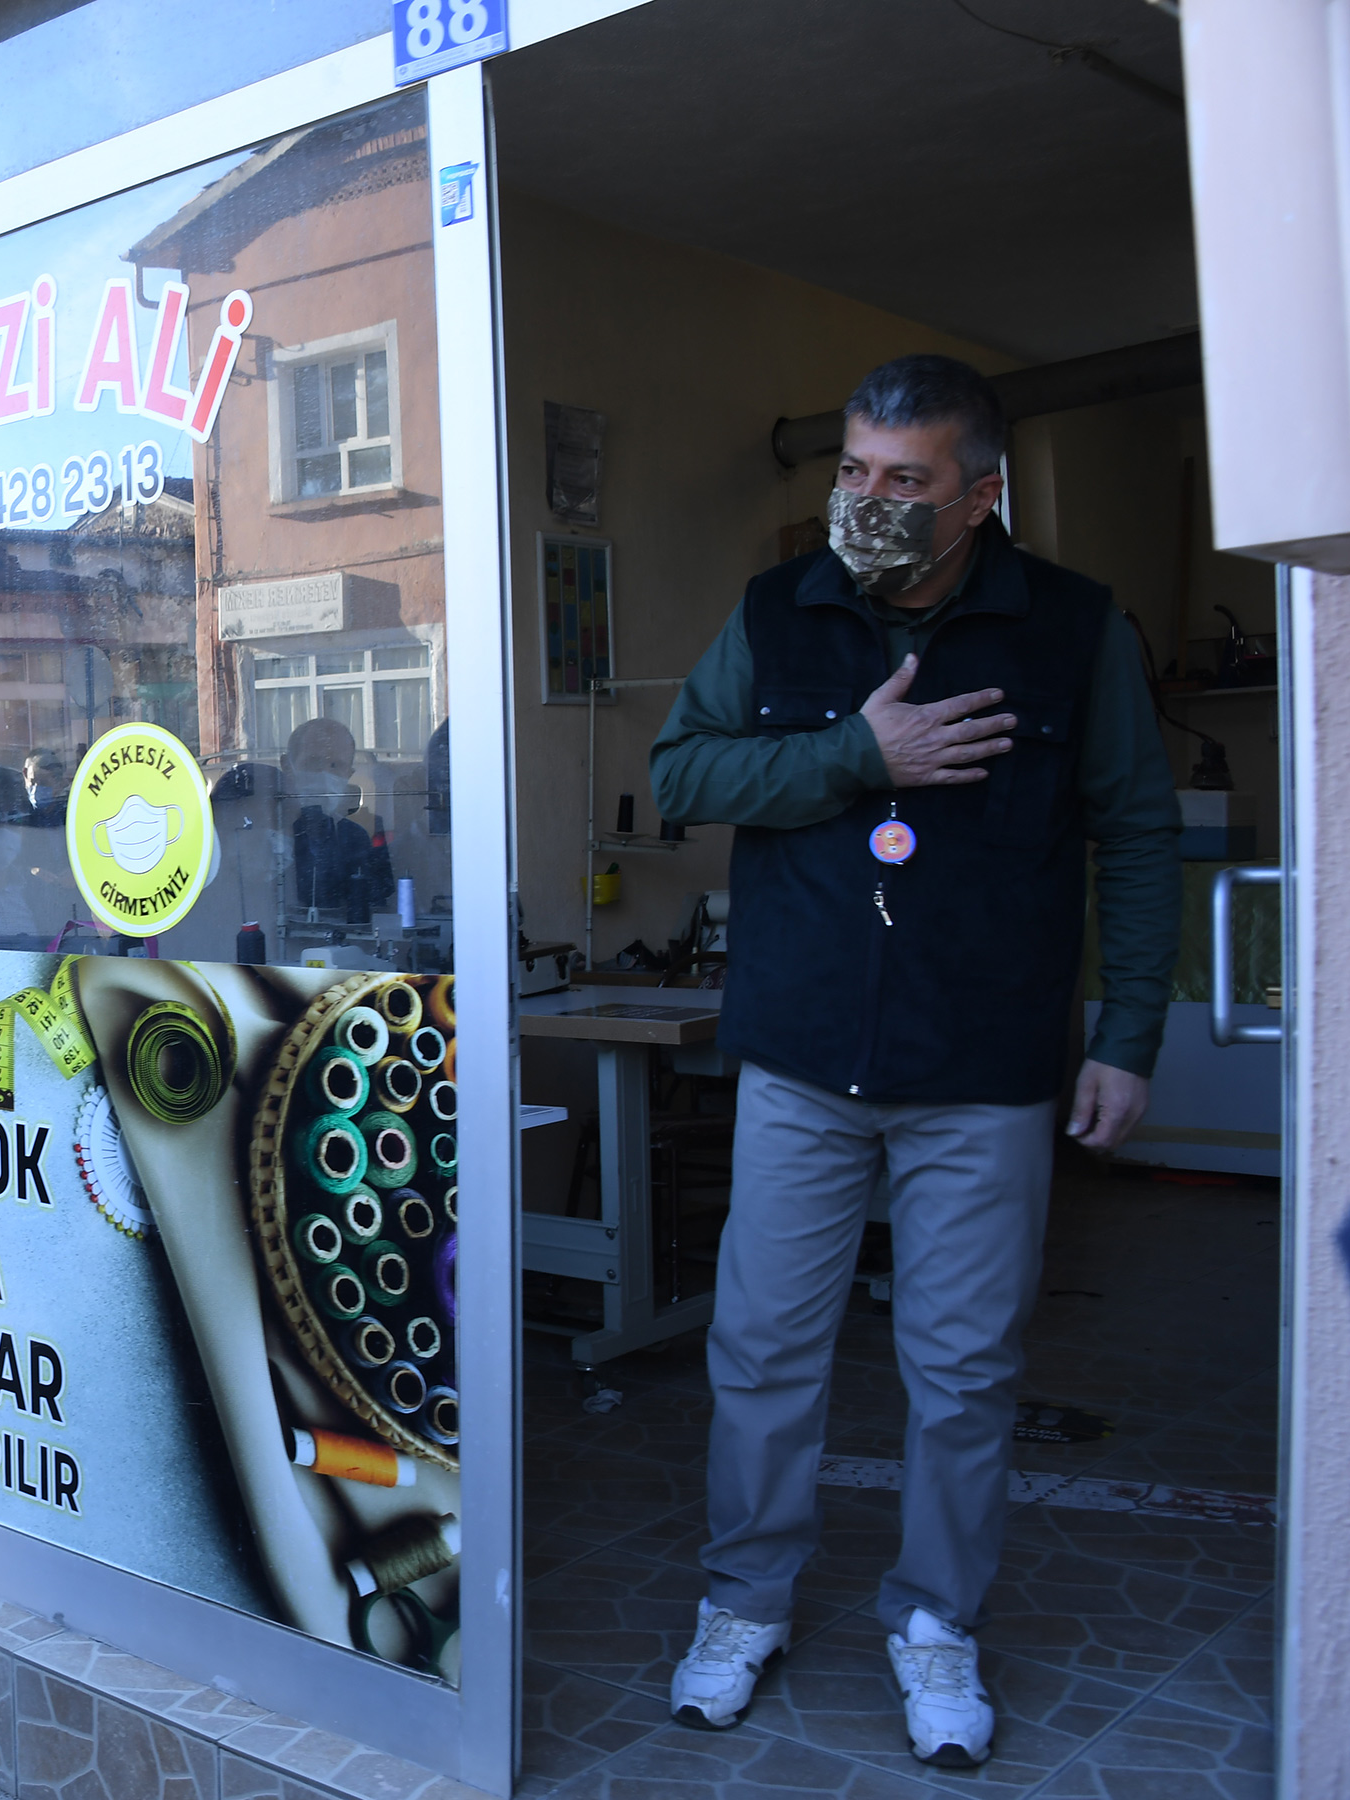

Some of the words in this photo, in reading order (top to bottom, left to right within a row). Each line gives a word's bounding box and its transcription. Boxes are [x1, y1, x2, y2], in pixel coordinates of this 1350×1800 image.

[406, 0, 489, 60] 88
[75, 278, 254, 443] ALİ
[61, 451, 113, 518] 23
[121, 441, 164, 507] 13
[87, 745, 177, 797] MASKESİZ
[100, 865, 190, 916] GİRMEYİNİZ
